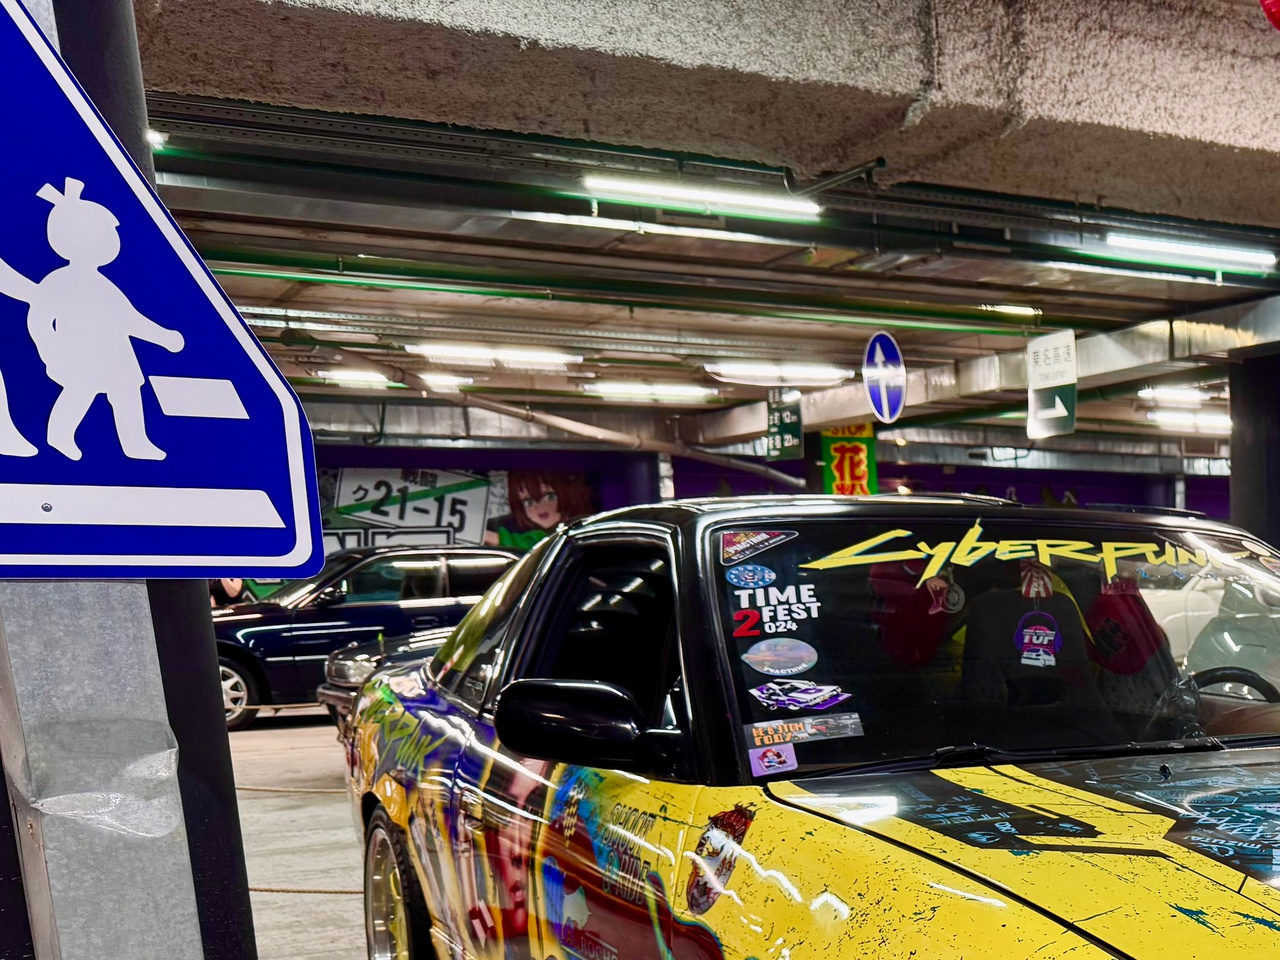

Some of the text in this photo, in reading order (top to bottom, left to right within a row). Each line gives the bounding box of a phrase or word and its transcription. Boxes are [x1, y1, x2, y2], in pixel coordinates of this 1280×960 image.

[370, 480, 469, 533] 21-15
[734, 584, 817, 609] TIME
[761, 602, 822, 623] FEST
